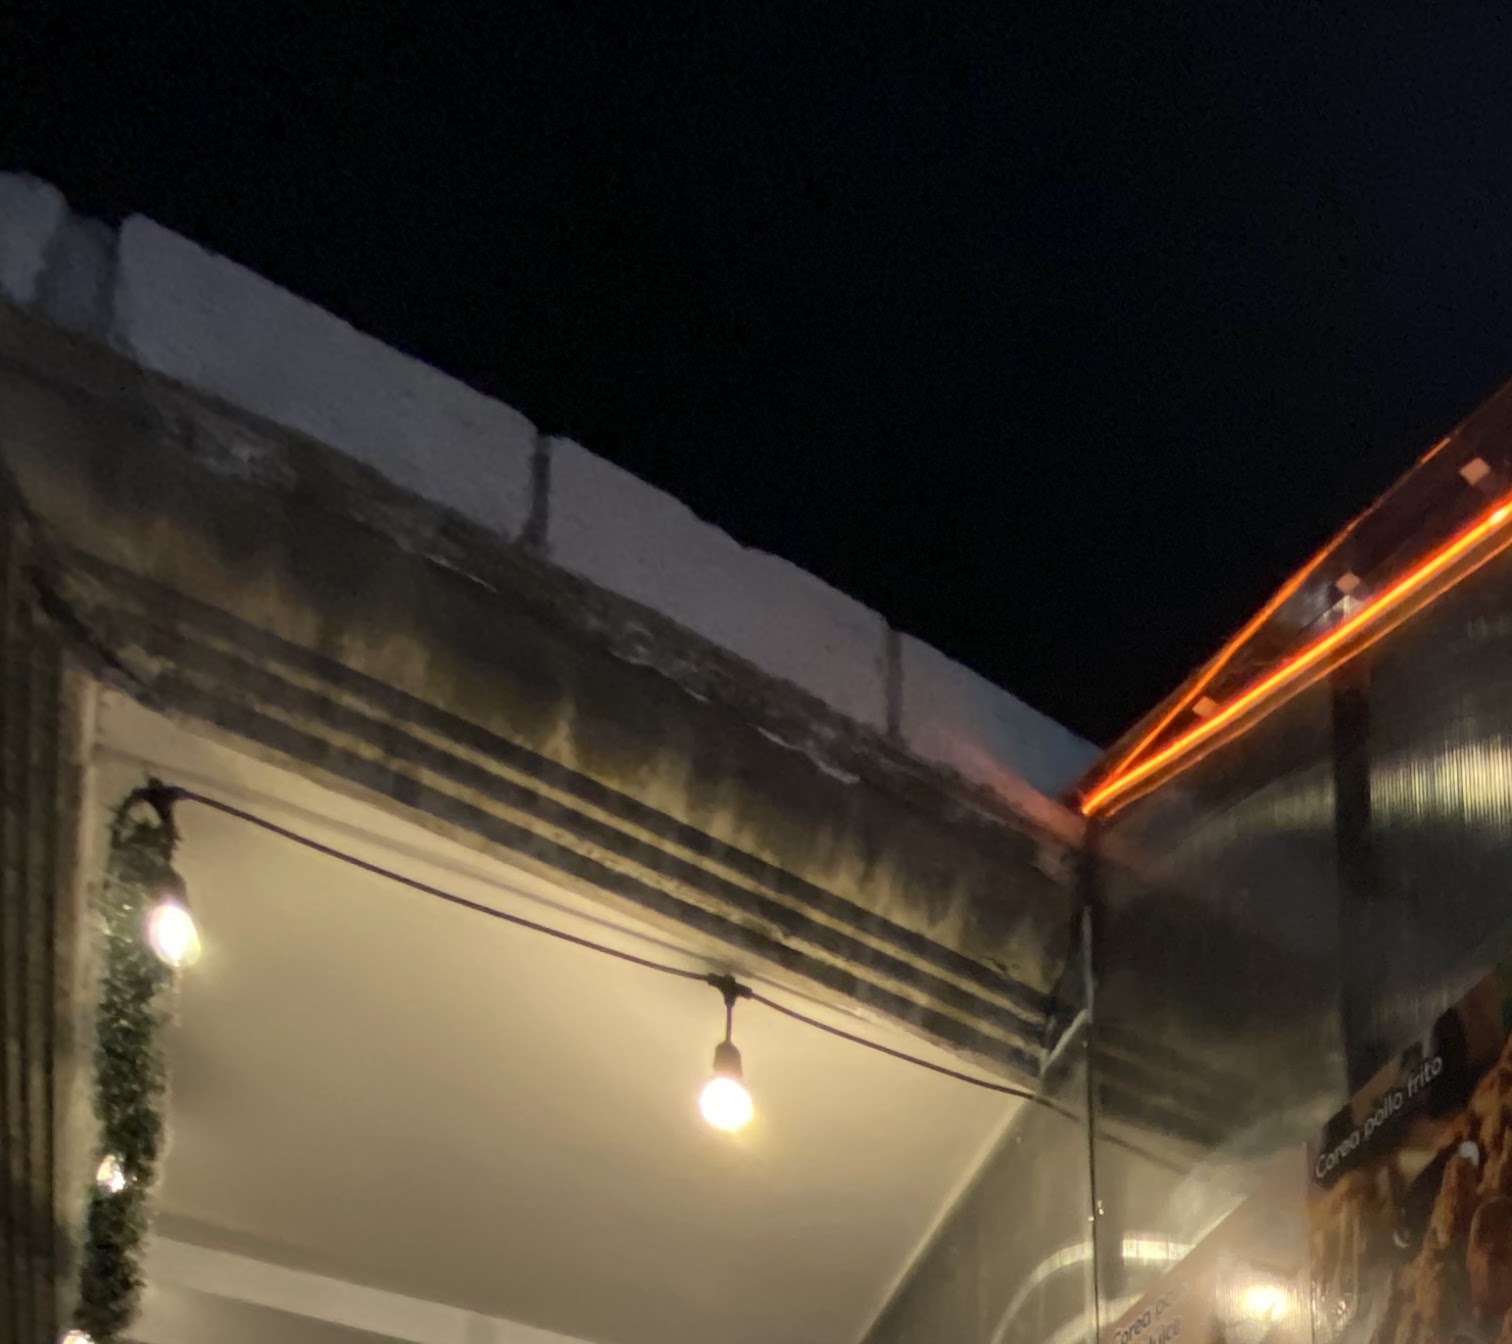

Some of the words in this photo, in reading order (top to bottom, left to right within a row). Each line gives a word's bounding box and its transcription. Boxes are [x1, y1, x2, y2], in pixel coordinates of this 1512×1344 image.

[1315, 1129, 1361, 1179] Corea
[1364, 1091, 1403, 1142] pollo
[1407, 1056, 1443, 1098] frito
